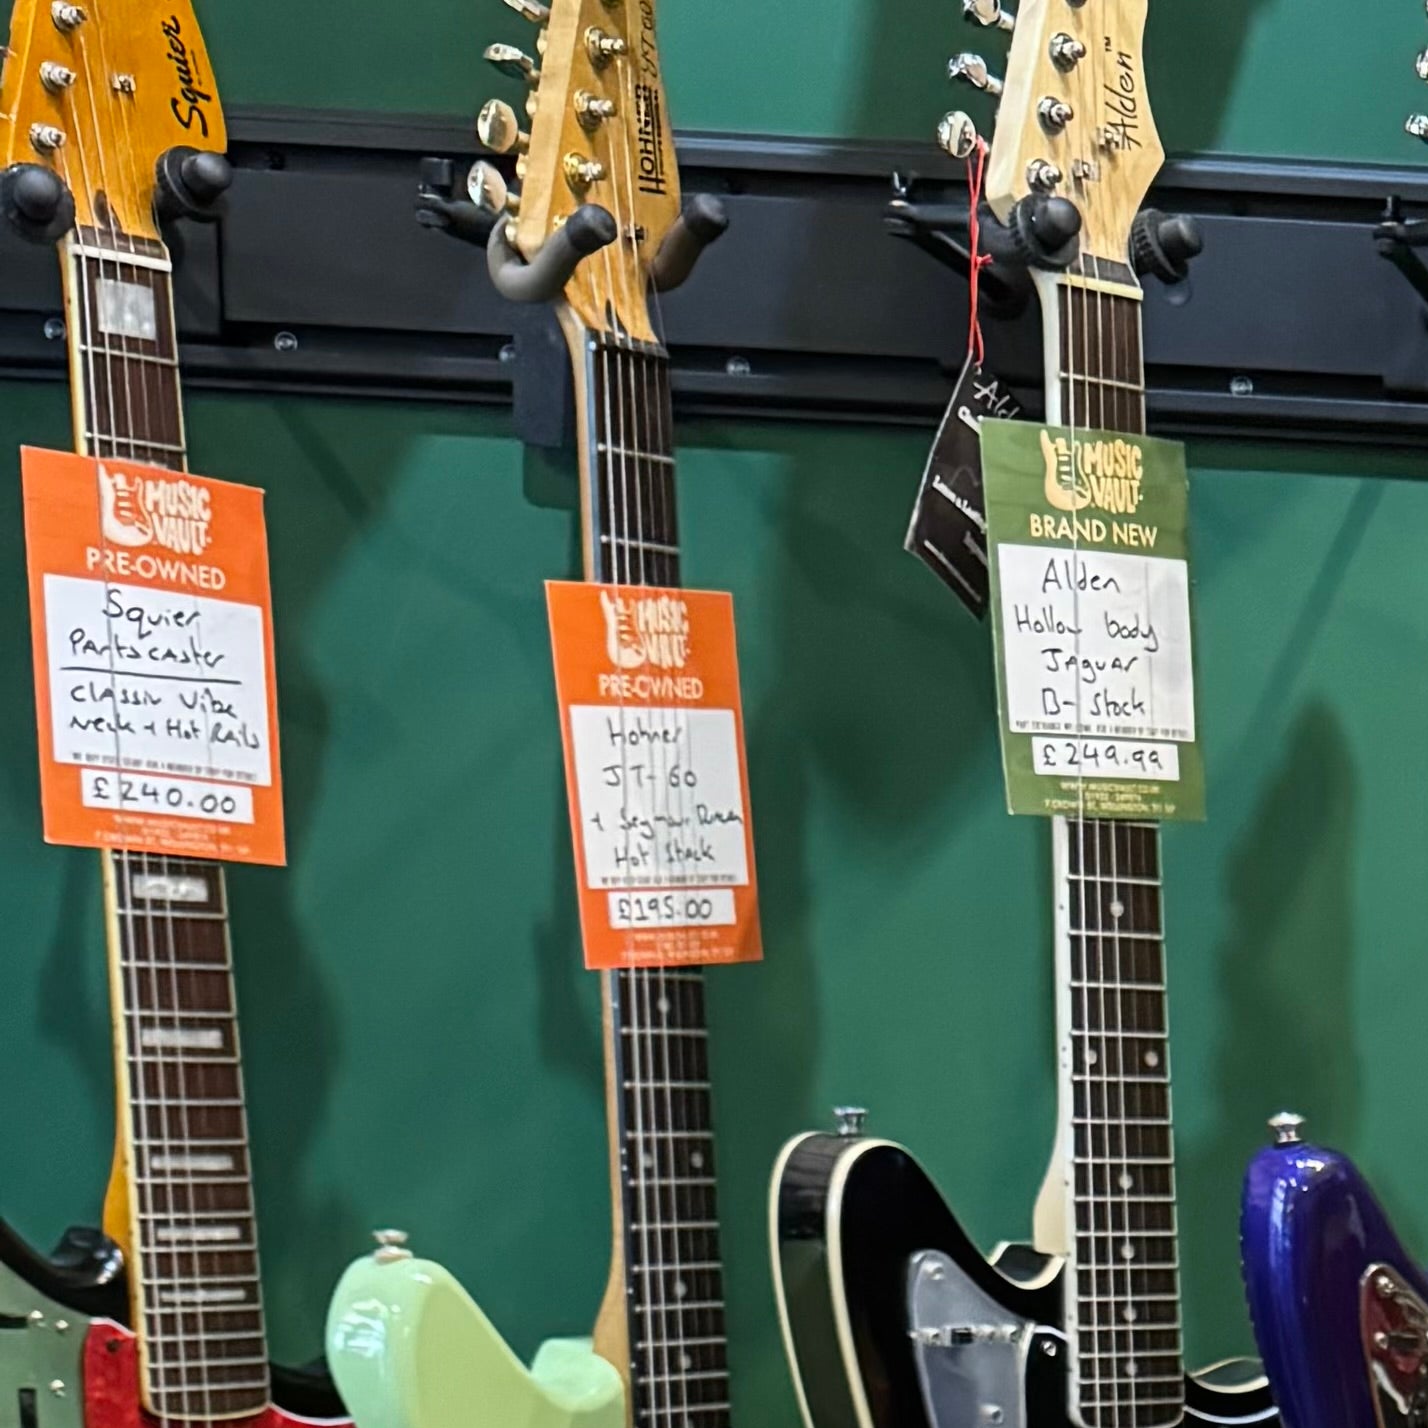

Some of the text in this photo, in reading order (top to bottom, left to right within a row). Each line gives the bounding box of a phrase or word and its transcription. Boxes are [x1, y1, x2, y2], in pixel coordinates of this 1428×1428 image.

[161, 15, 211, 138] Squier
[1103, 51, 1143, 152] Alden
[1083, 438, 1144, 480] MUSIC
[146, 480, 212, 521] MUSIC
[1088, 478, 1144, 515] VAULT
[150, 517, 211, 555] VAULT
[1029, 512, 1159, 548] BRAND NEW
[86, 546, 227, 592] PRE-OWNED
[1041, 557, 1122, 594] Alden
[101, 588, 202, 640] Squier
[637, 596, 690, 634] MUSIC
[1103, 611, 1159, 653] body
[1041, 648, 1139, 684] Jaguar
[599, 674, 704, 700] PRE-OWNED
[167, 718, 201, 738] Hot
[210, 724, 261, 750] Rails
[1042, 743, 1164, 773] £249.99
[92, 776, 237, 815] £240.00
[613, 842, 650, 869] Hot
[617, 896, 714, 922] £195.00
